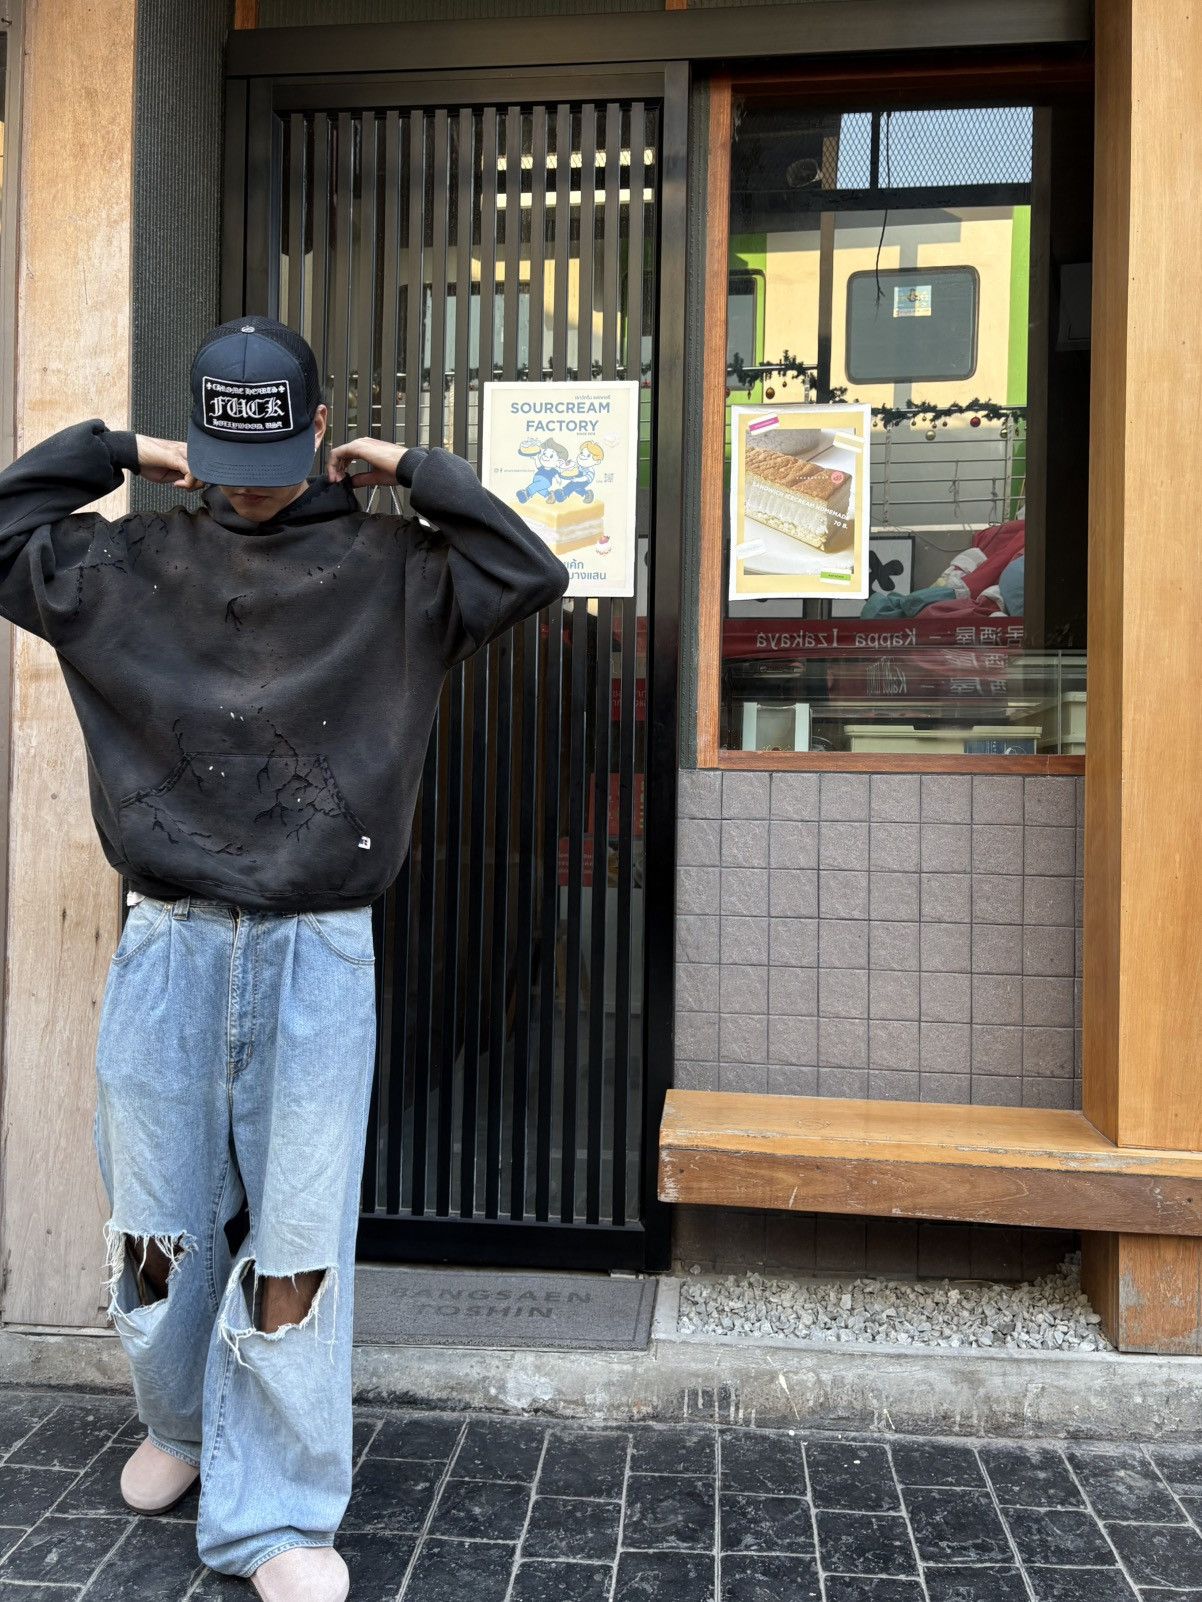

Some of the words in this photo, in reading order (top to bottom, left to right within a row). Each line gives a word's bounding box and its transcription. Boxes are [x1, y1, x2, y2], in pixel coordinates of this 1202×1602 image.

[209, 396, 285, 418] FUCK
[510, 402, 610, 414] SOURCREAM
[525, 420, 599, 432] FACTORY
